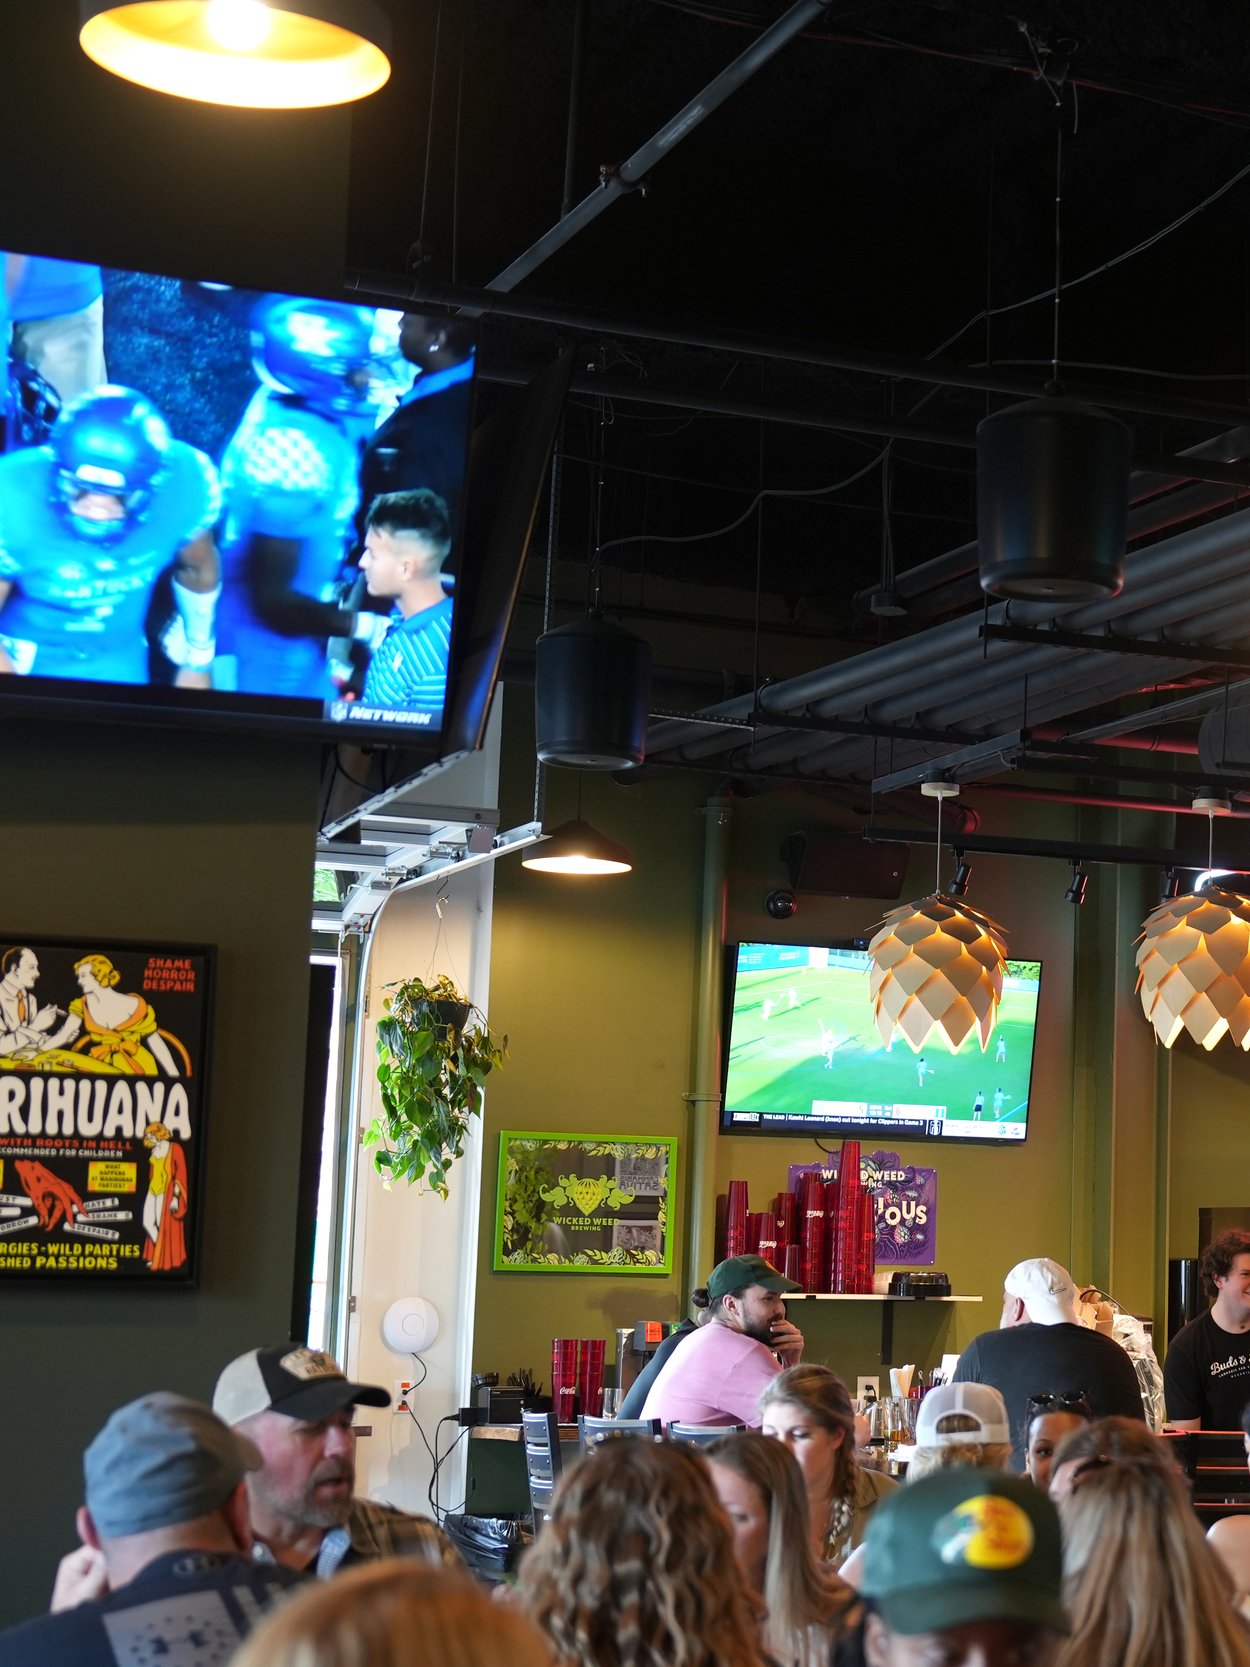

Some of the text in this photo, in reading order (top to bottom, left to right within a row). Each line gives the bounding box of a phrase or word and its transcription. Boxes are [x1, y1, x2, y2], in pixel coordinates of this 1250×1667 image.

[349, 706, 432, 725] NETWORK
[148, 957, 192, 968] SHAME
[143, 968, 196, 980] HORROR
[143, 979, 195, 992] DESPAIR
[851, 1117, 869, 1125] tonight
[878, 1118, 898, 1126] Clippers
[0, 1137, 133, 1150] WITH ROOTS IN HELL
[59, 1148, 76, 1157] FOR
[78, 1149, 123, 1159] CHILDREN
[822, 1169, 905, 1180] WID WEED
[553, 1217, 620, 1226] WICKED WEED
[85, 1243, 140, 1257] PARTIES
[36, 1256, 118, 1269] PASSIONS
[1210, 1356, 1238, 1375] Buds
[1239, 1355, 1246, 1364] &
